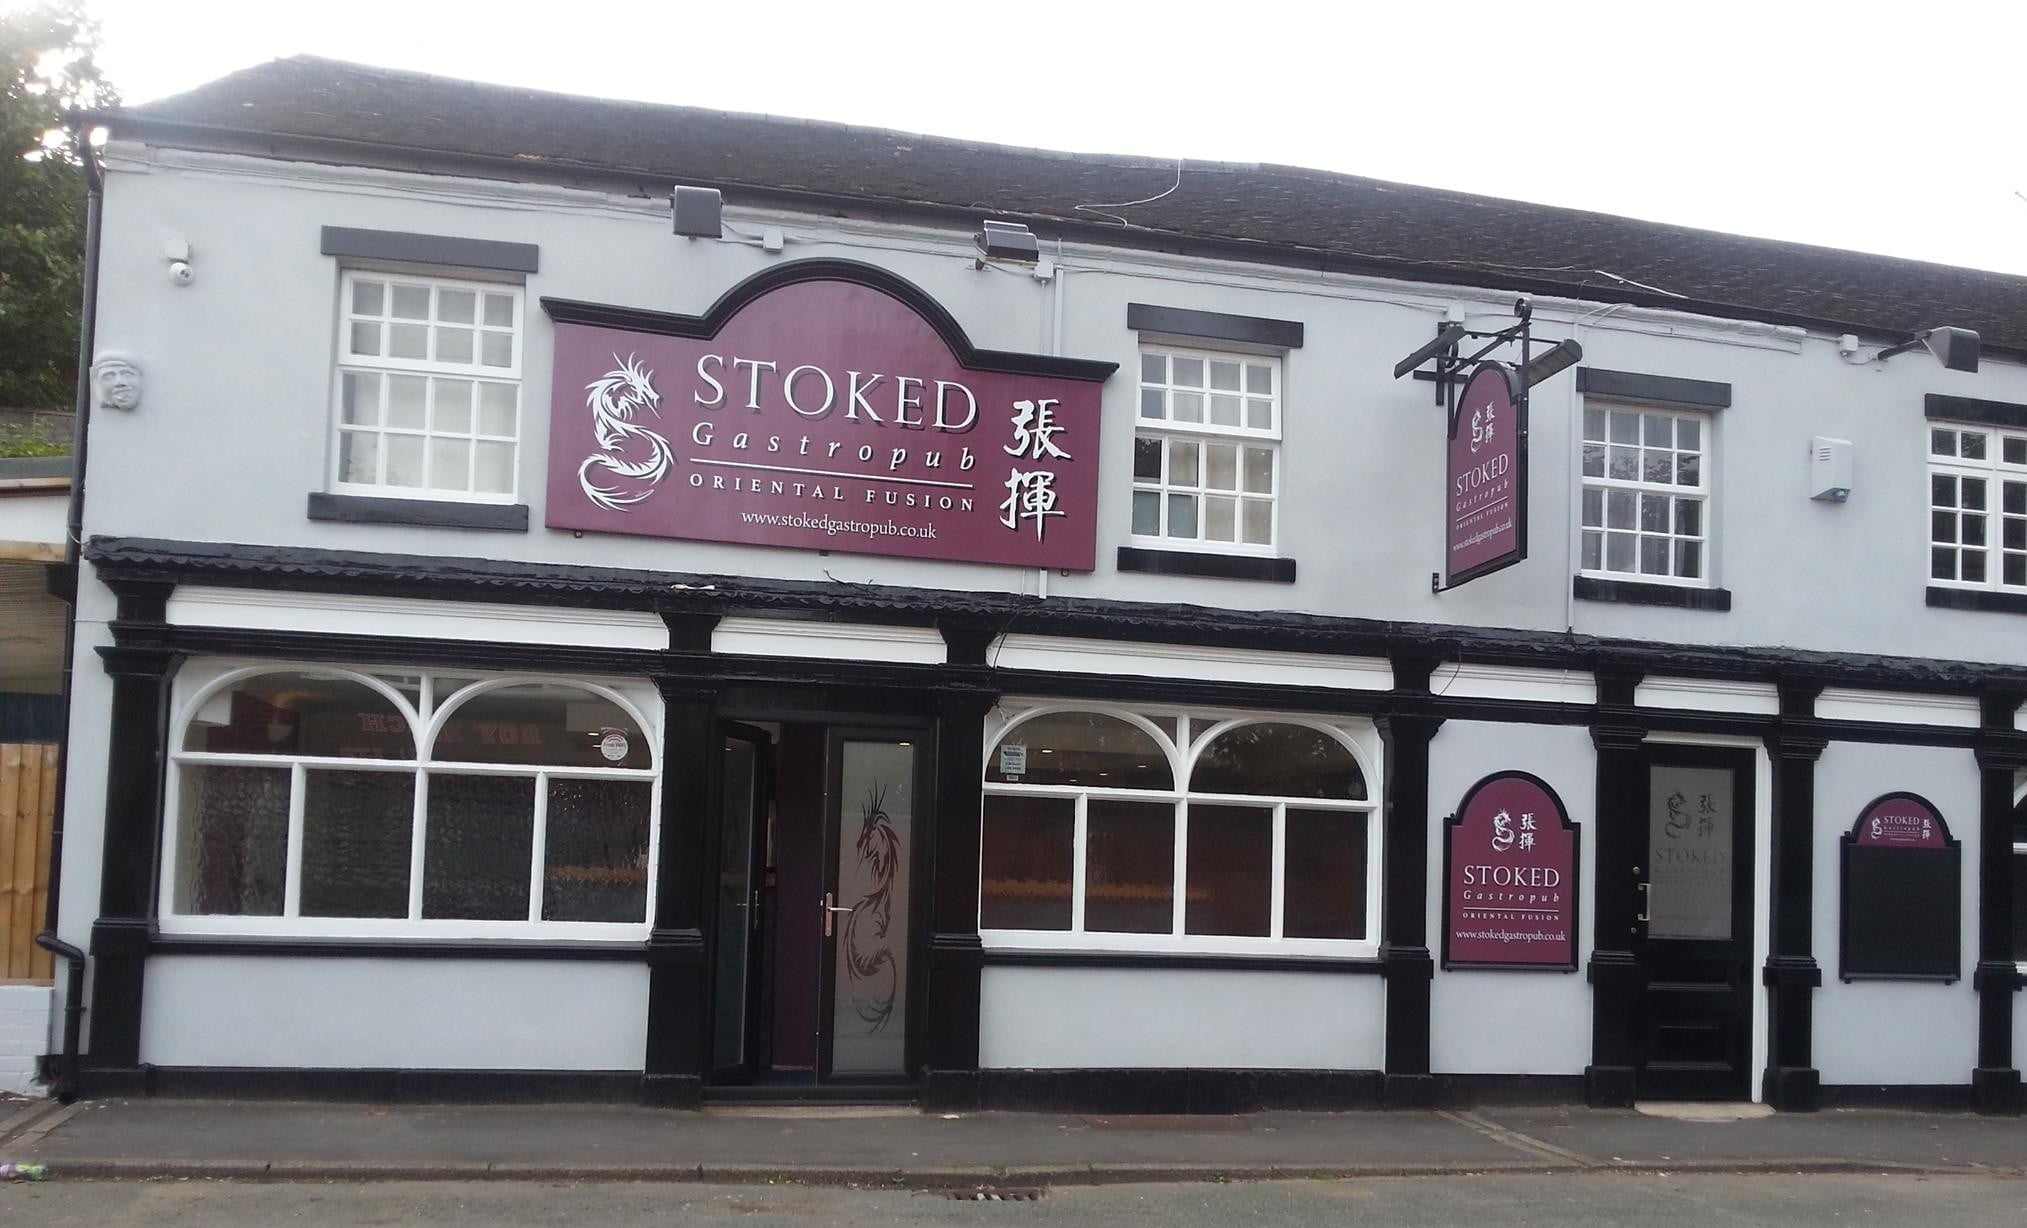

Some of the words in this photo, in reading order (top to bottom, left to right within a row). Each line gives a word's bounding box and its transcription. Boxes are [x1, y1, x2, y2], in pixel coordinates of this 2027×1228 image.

[694, 354, 978, 430] STOKED
[692, 422, 975, 472] Gastropub
[1456, 454, 1508, 497] STOKED
[690, 473, 843, 500] ORIENTAL
[867, 489, 974, 512] FUSION
[742, 511, 937, 540] www.stokedgastropub.co.uk
[1883, 816, 1920, 825] STOKED
[1655, 847, 1725, 864] STOKED
[1463, 865, 1560, 888] STOKED
[1463, 890, 1560, 903] Gastropub
[1462, 912, 1515, 920] ORIENTAL
[1456, 929, 1566, 943] www.stokedgastropub.co.uk
